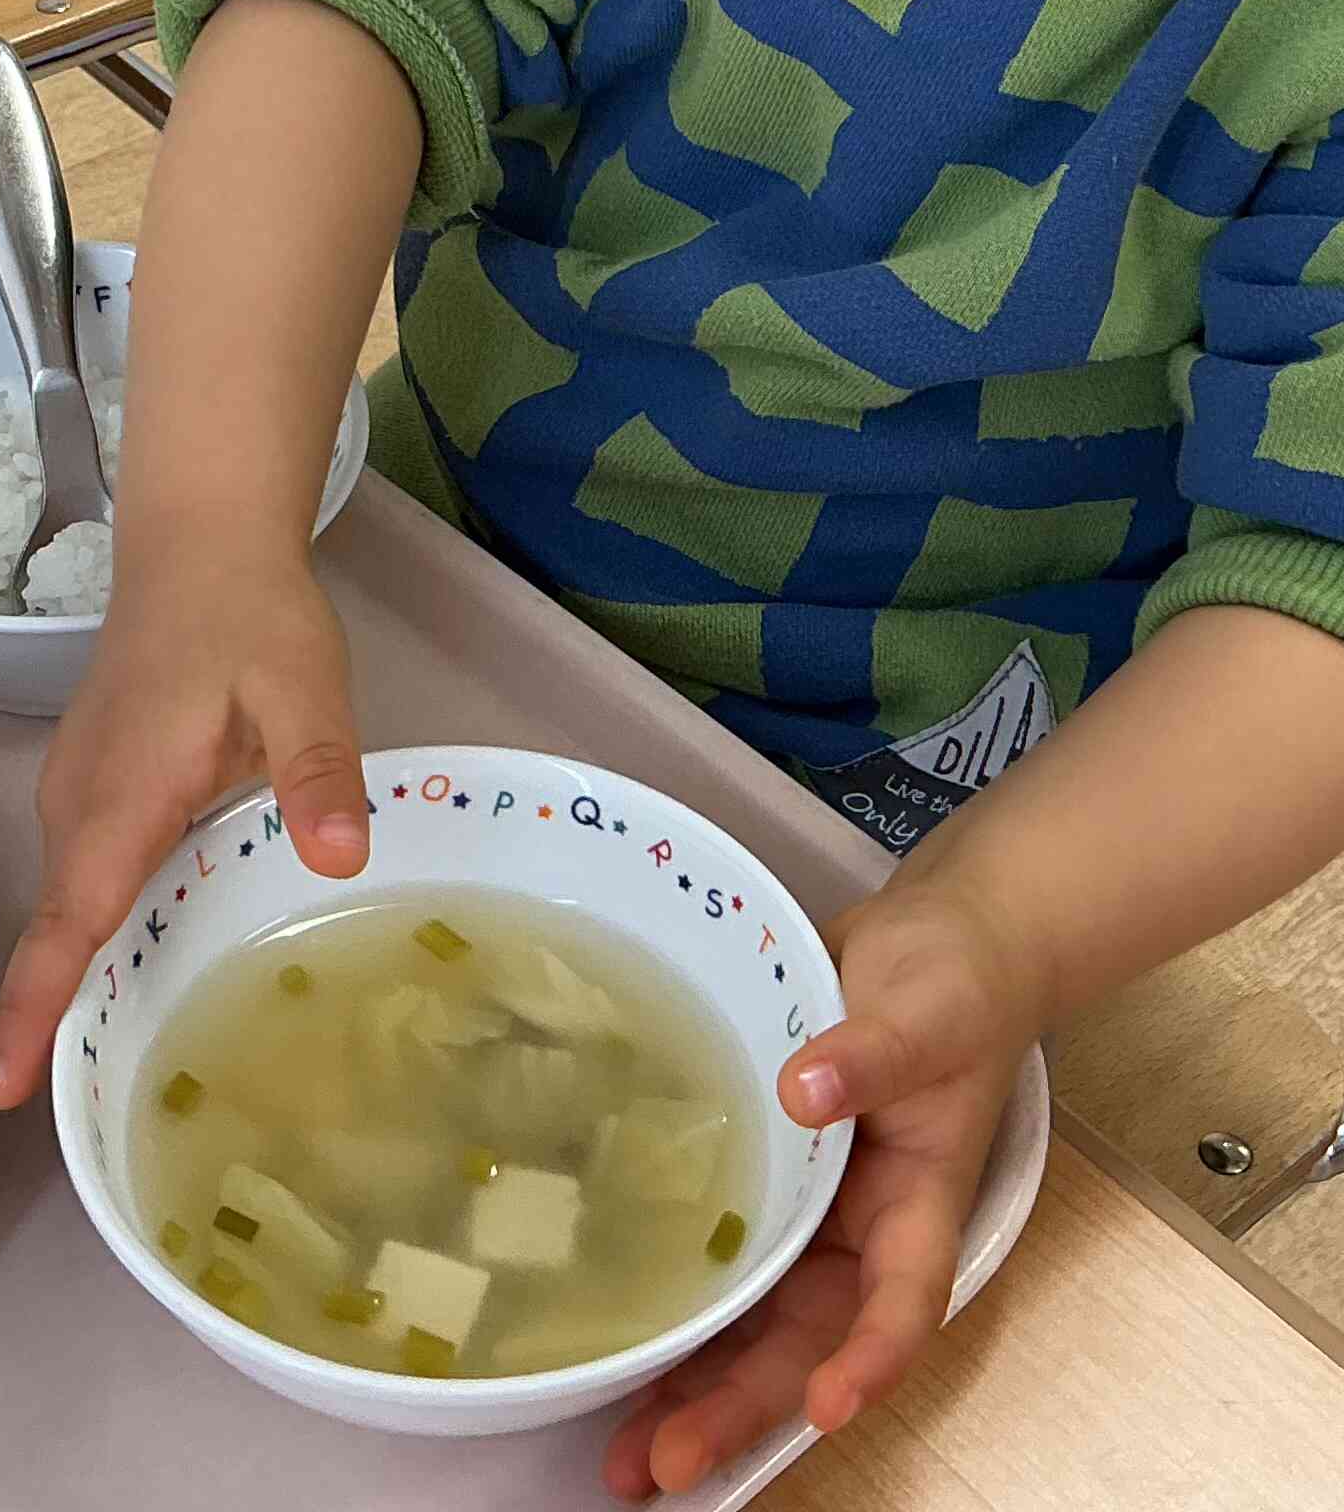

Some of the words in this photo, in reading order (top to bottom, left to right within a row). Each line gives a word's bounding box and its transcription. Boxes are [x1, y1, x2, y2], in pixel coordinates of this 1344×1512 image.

[93, 285, 112, 314] F
[932, 680, 1047, 787] DILA
[841, 792, 920, 846] Only
[884, 773, 927, 805] Live
[928, 794, 954, 815] th
[104, 962, 118, 1001] J
[145, 908, 169, 944] K
[196, 848, 217, 878] L
[420, 774, 452, 803] O
[492, 790, 515, 818] P
[570, 795, 605, 831] Q
[647, 838, 673, 868] R
[704, 888, 724, 919] S
[758, 923, 777, 955] T
